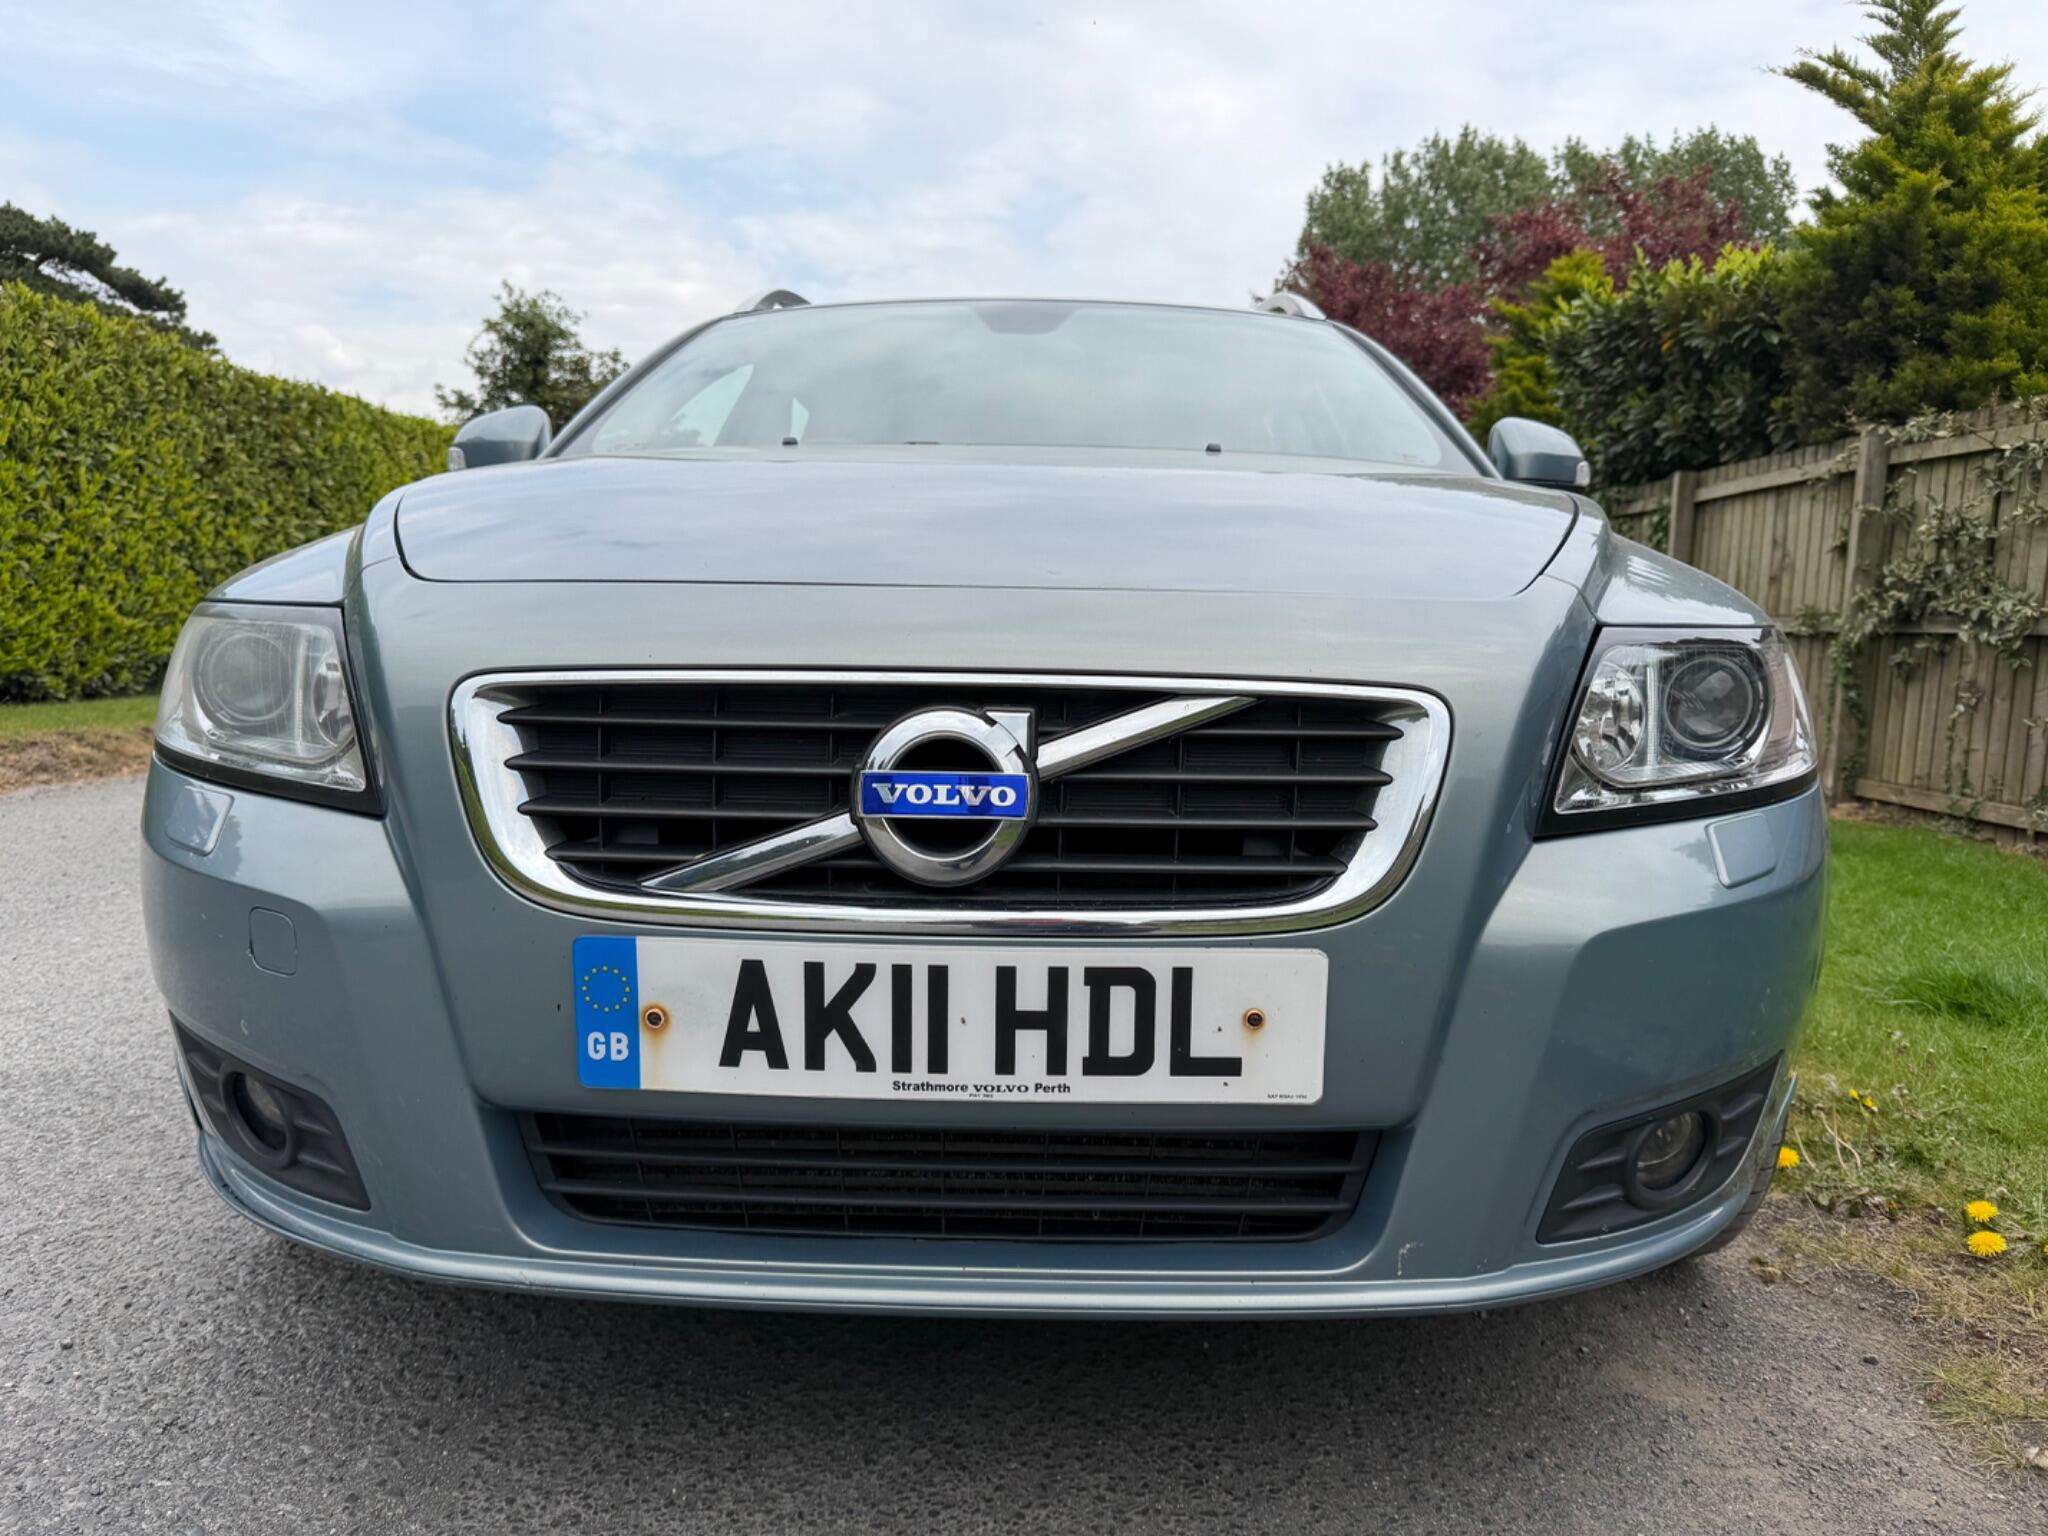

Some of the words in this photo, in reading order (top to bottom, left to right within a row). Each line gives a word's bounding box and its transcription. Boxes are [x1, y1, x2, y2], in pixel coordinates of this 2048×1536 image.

[872, 783, 1017, 807] VOLVO
[718, 958, 949, 1074] AK11
[995, 965, 1243, 1078] HDL
[587, 1031, 629, 1061] GB
[892, 1080, 969, 1092] Strathmore
[973, 1083, 1029, 1093] VOLVO
[1034, 1082, 1071, 1094] Perth
